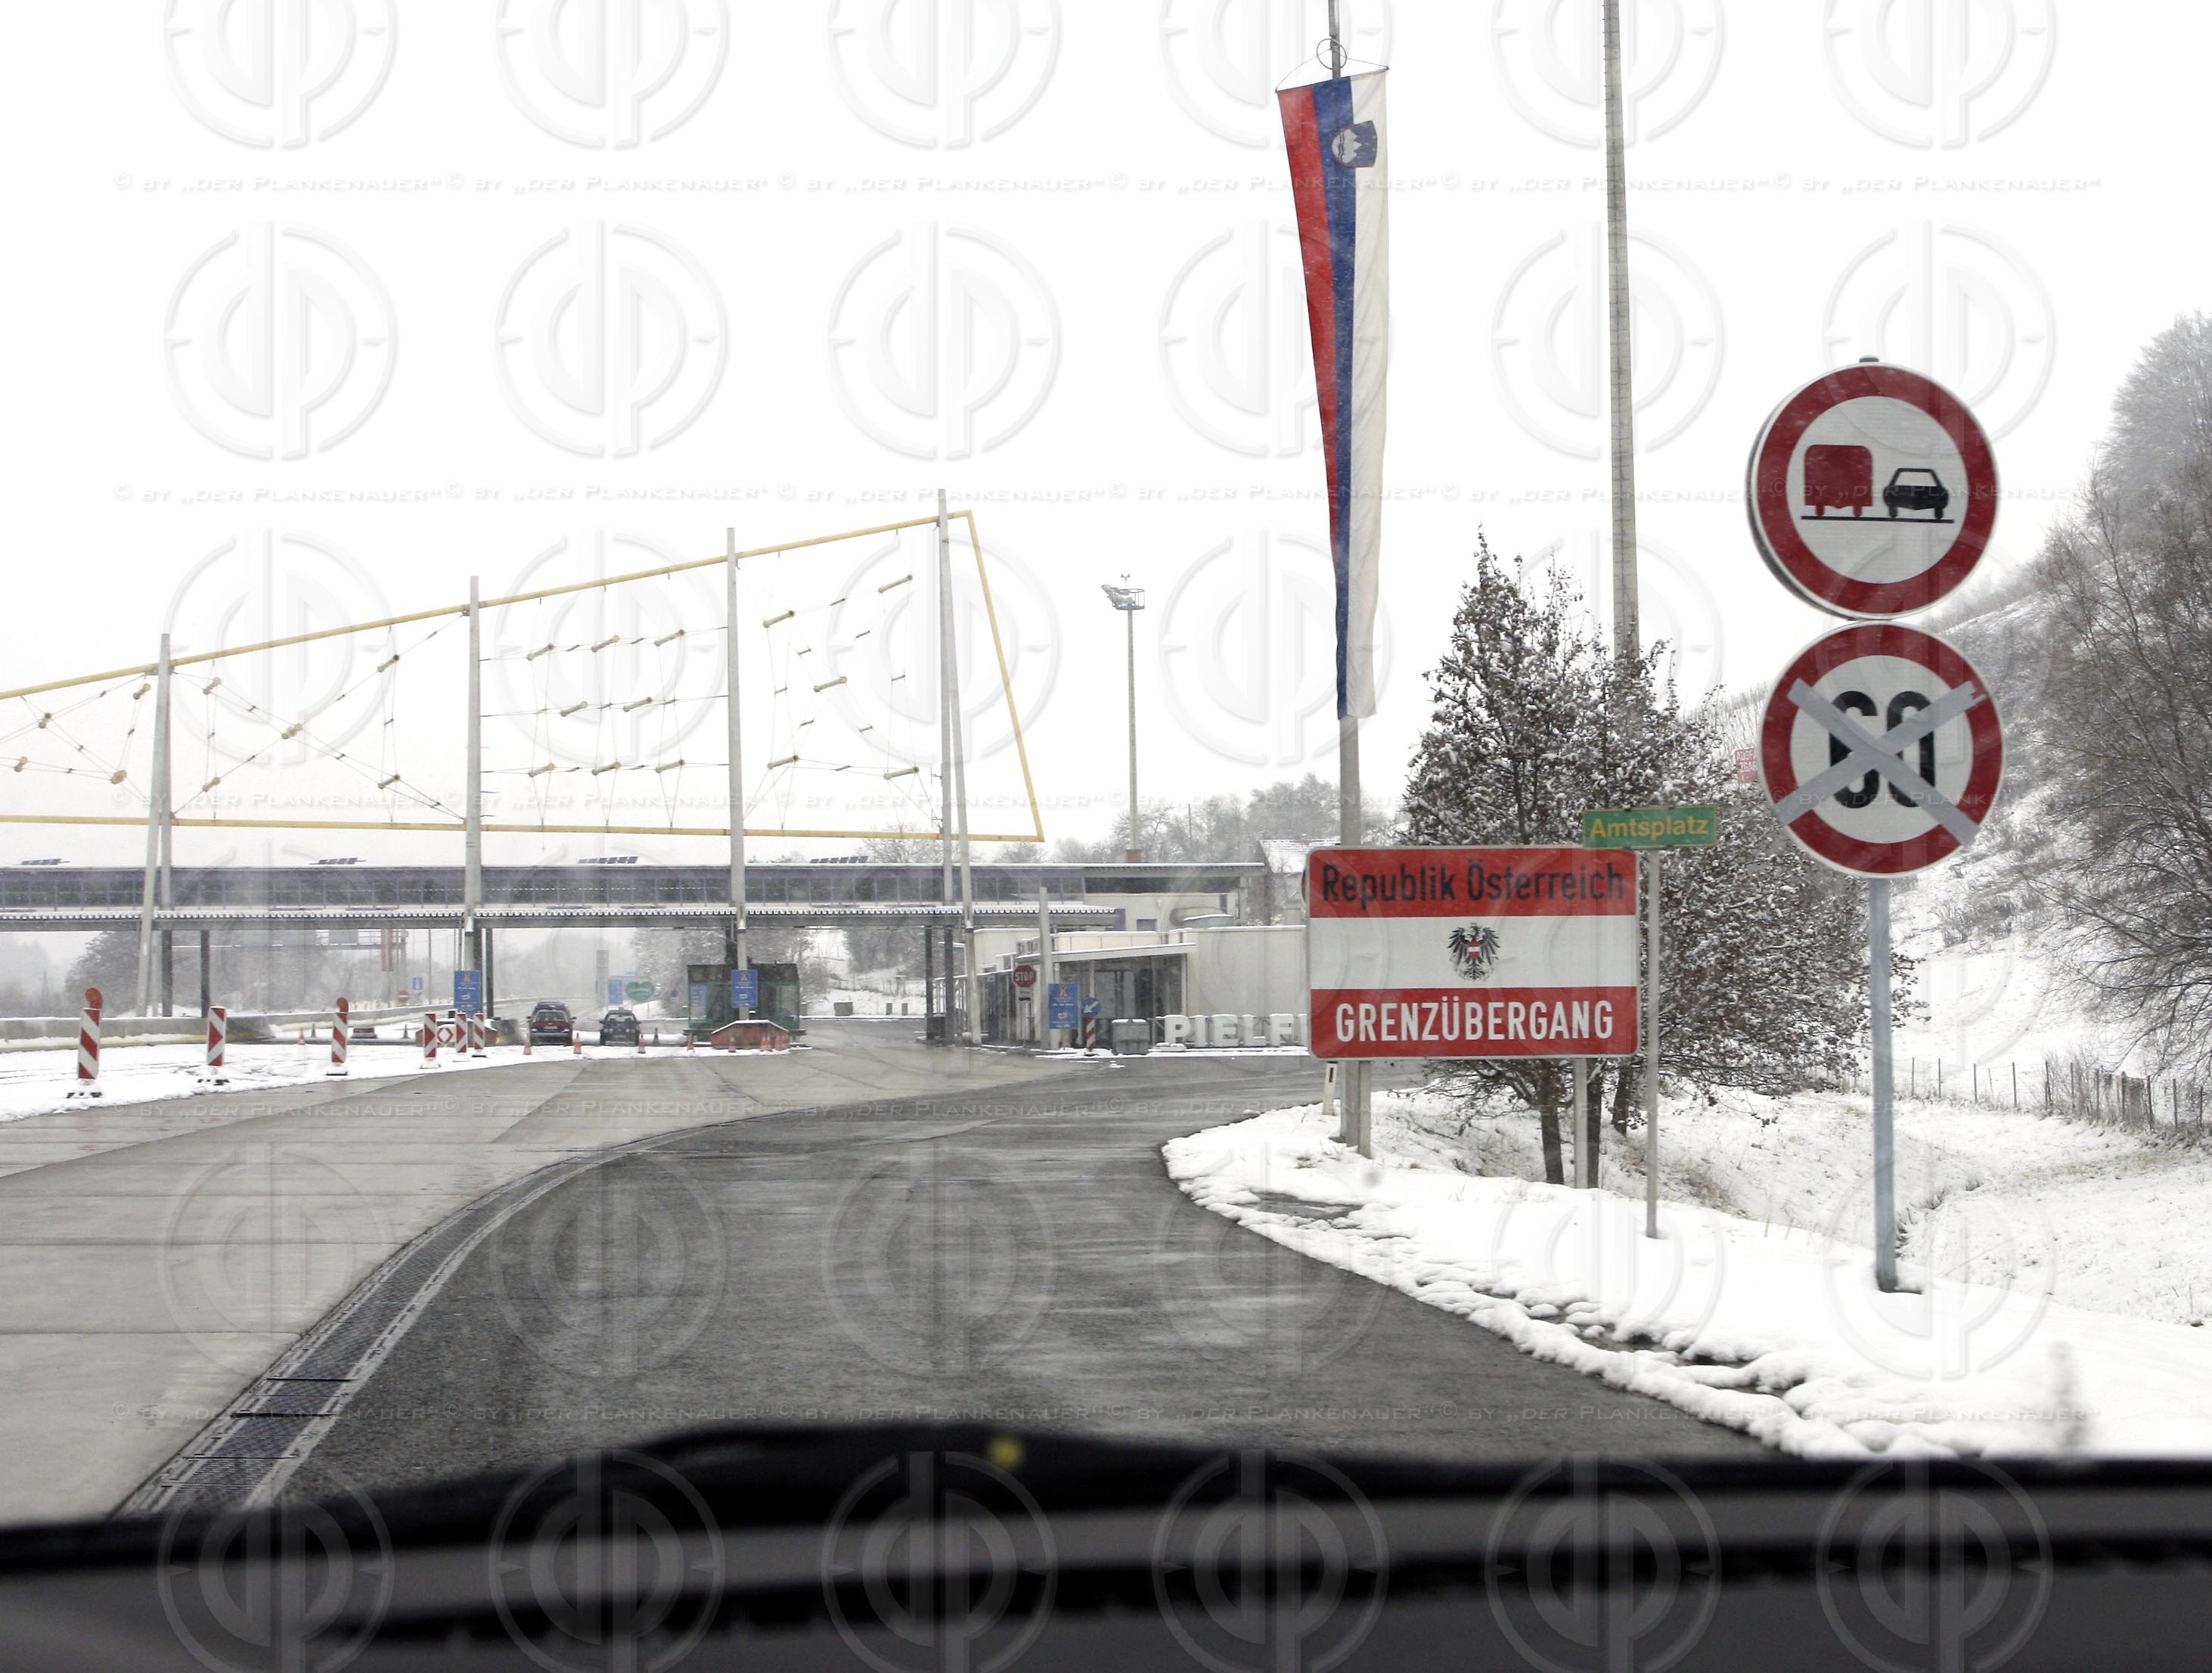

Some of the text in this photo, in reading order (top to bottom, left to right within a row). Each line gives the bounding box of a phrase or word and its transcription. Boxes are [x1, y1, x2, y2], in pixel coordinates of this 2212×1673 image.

[1590, 815, 1710, 840] Amtsplatz
[1322, 858, 1624, 911] Republik Österreich
[1015, 972, 1034, 981] STOP
[1336, 995, 1613, 1042] GRENZÜBERGANG
